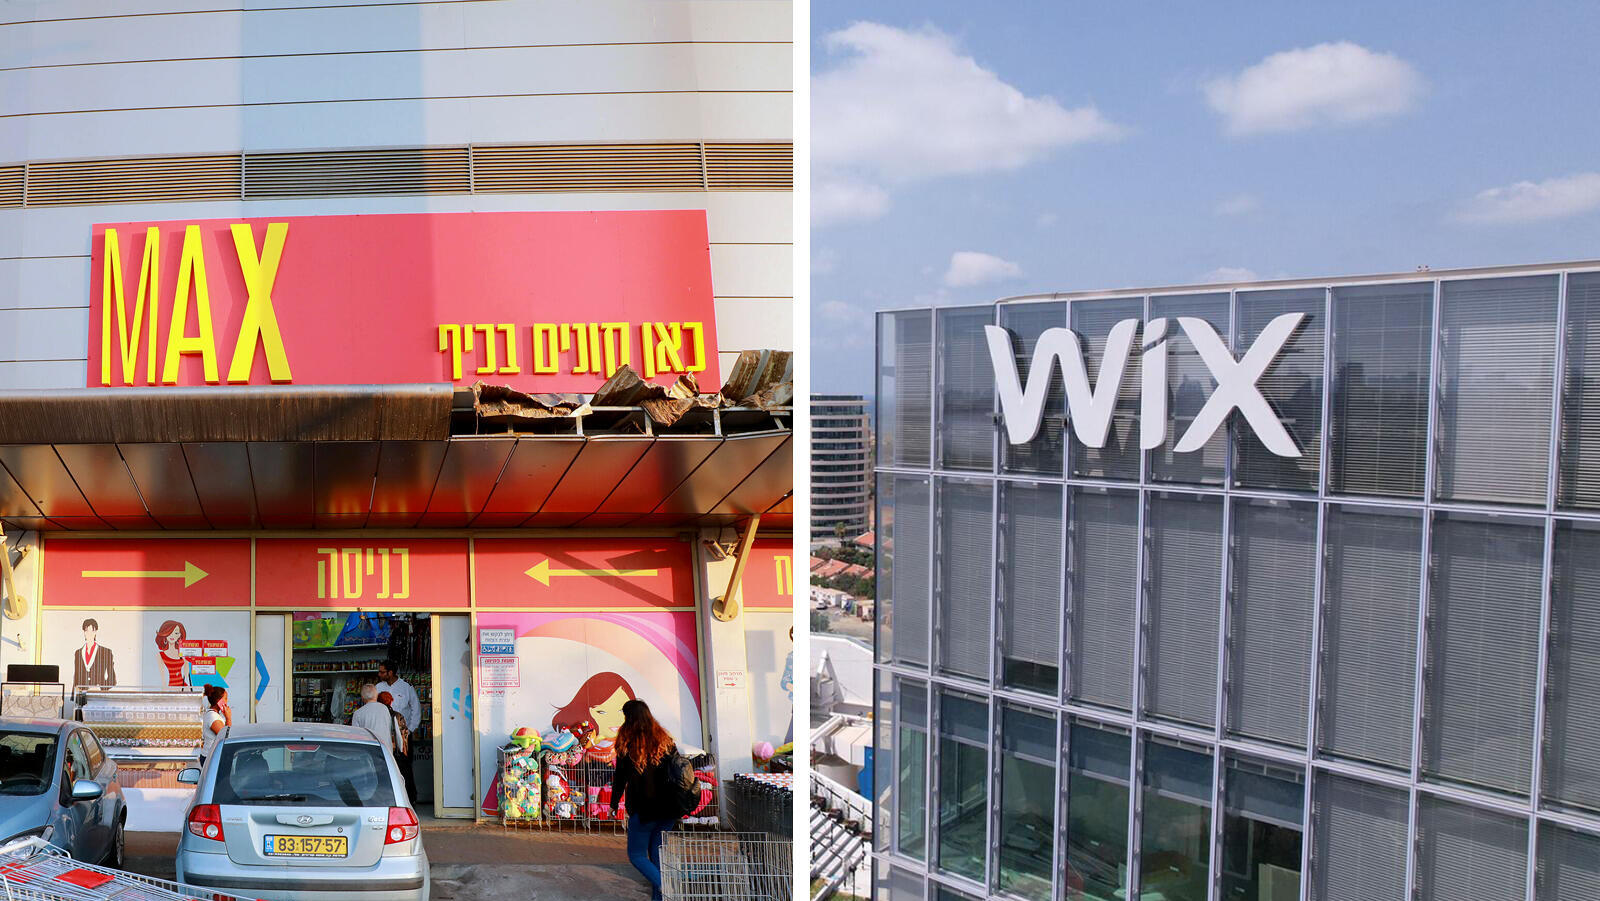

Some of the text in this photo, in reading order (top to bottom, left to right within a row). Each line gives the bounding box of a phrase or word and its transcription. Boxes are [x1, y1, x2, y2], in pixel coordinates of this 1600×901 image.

[99, 222, 293, 386] MAX
[438, 321, 707, 380] כאן קונים בכיף
[317, 547, 410, 599] כניסה
